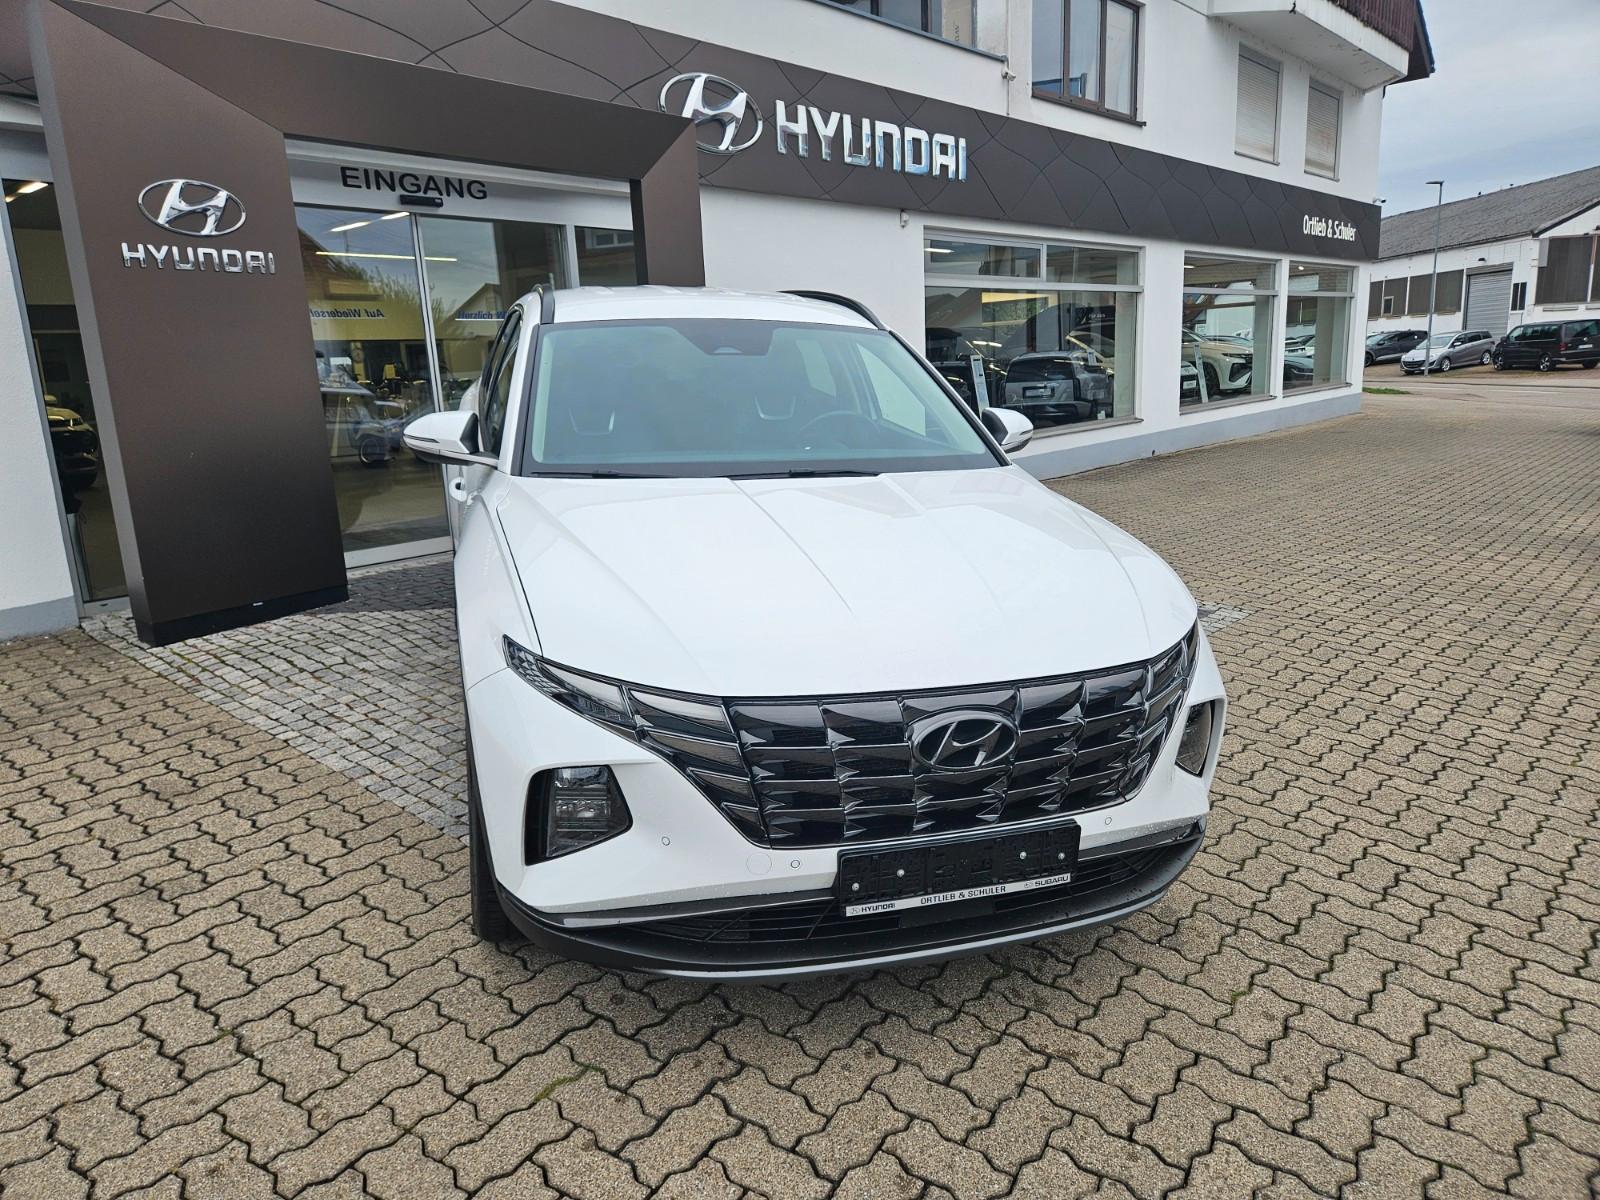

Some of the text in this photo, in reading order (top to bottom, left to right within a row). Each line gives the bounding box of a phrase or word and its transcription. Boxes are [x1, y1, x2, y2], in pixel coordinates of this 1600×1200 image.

[775, 99, 968, 183] HYUNDAI
[340, 166, 488, 200] EINGANG
[1303, 214, 1356, 242] Ortlieb & Schuler
[121, 242, 276, 275] HYUNDAI
[861, 874, 1069, 913] HYUNDAI ORTLIEB & SCHULER SUBARU
